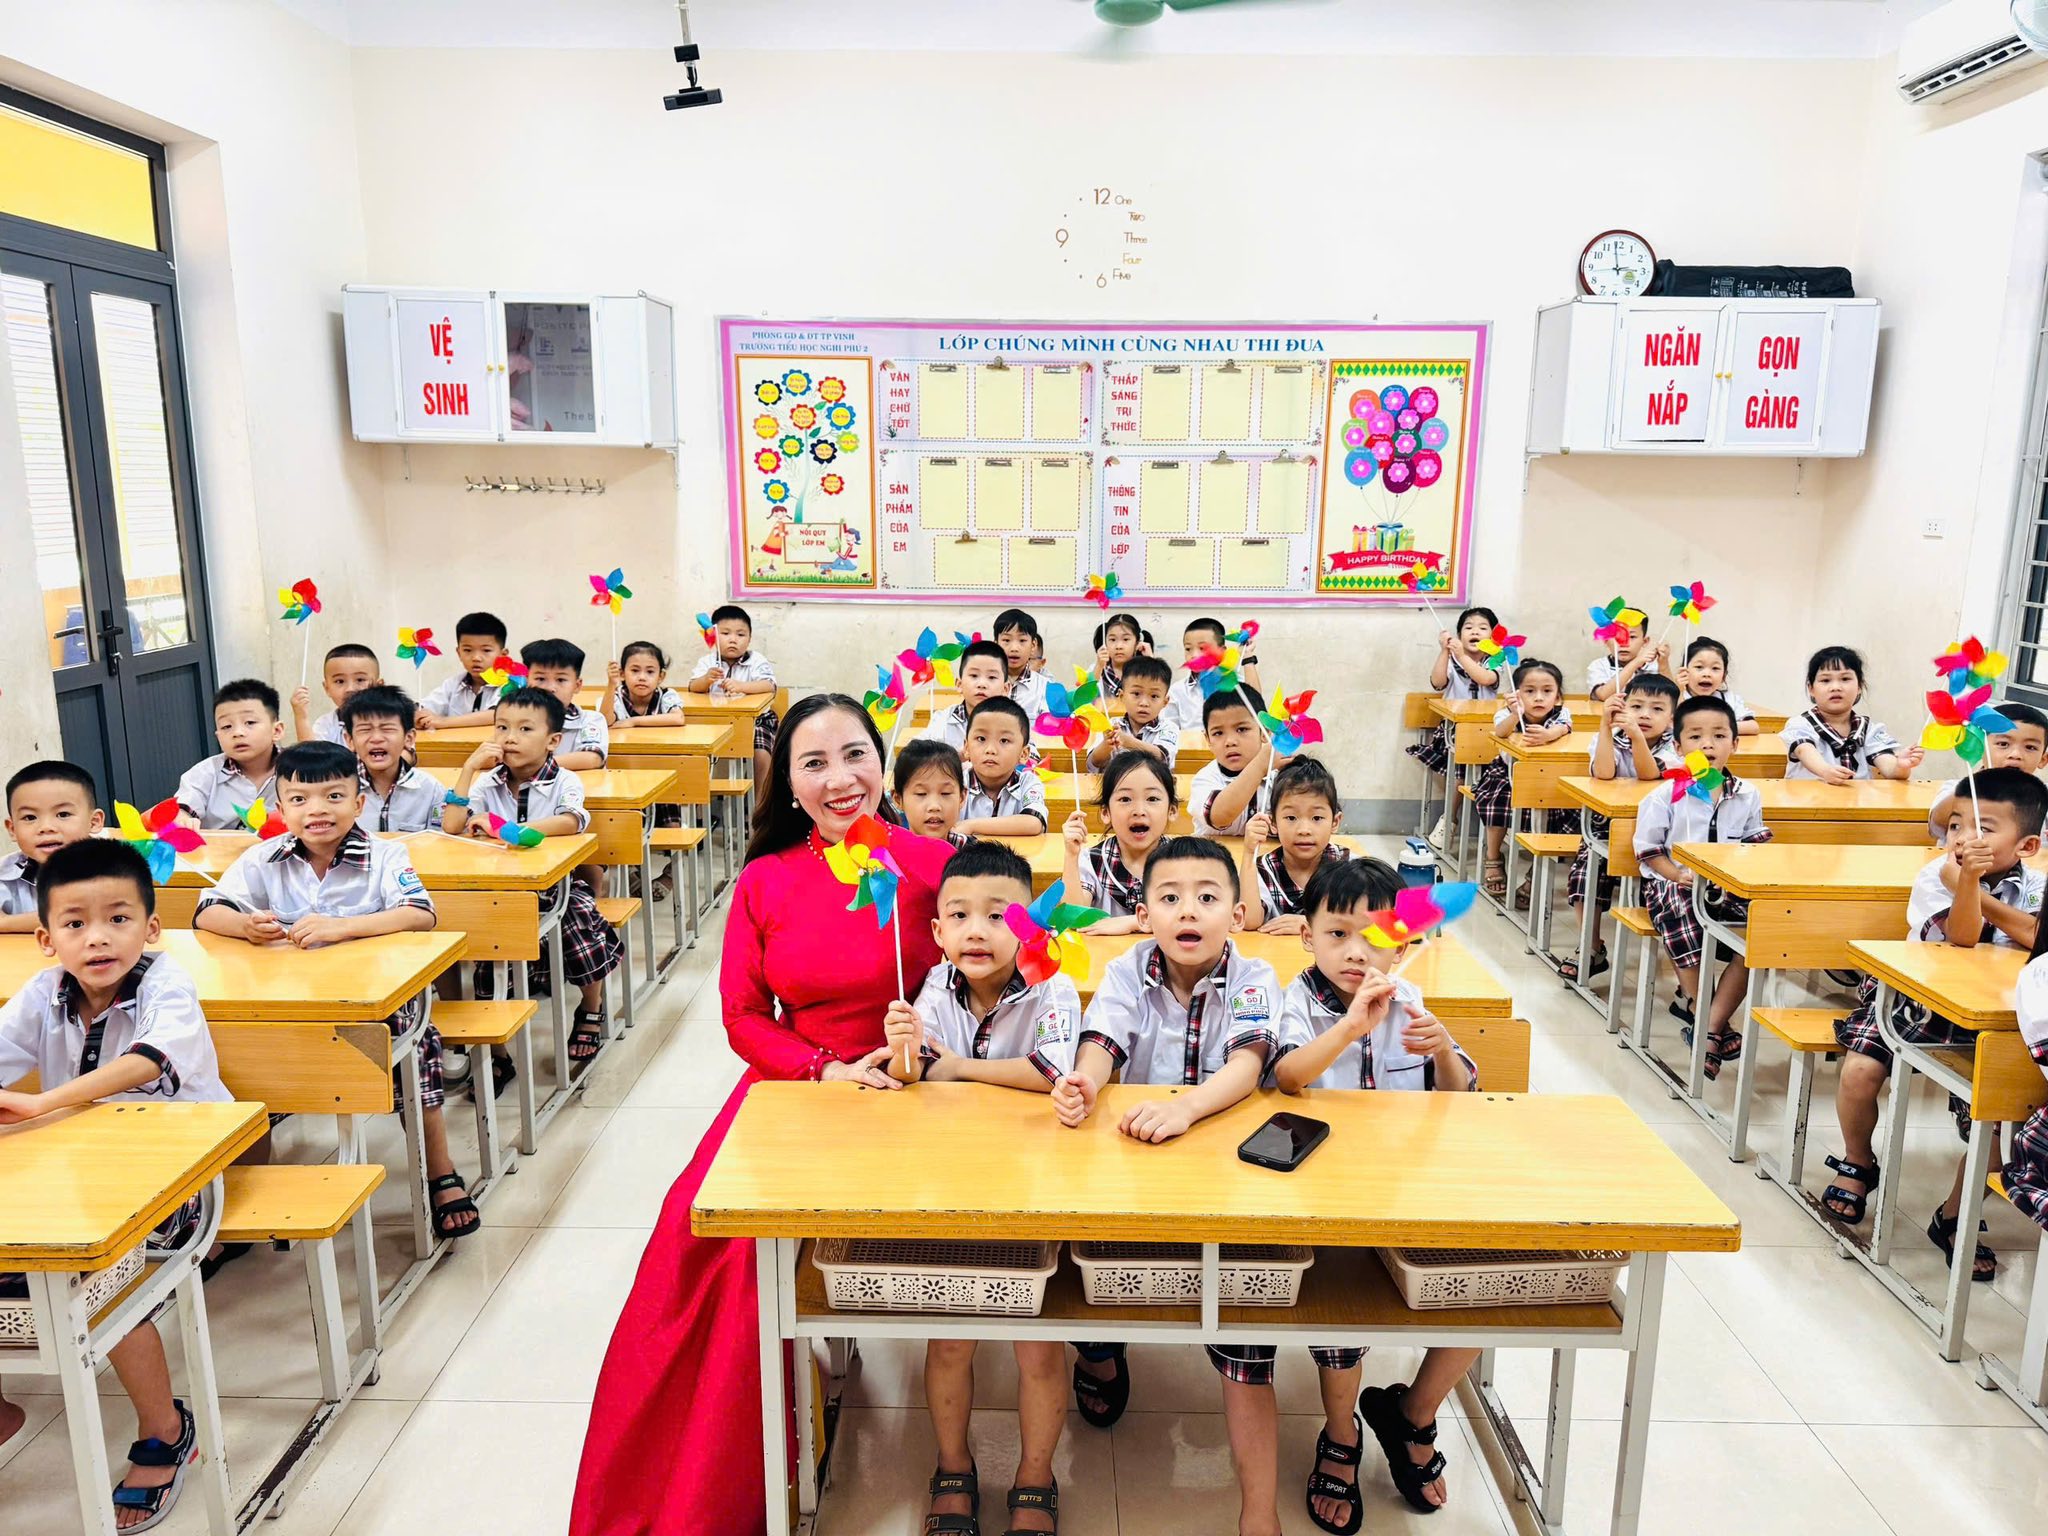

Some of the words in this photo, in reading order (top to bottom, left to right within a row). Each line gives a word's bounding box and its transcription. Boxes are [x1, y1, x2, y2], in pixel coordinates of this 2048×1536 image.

[1094, 188, 1111, 205] 12
[1056, 228, 1069, 248] 9
[1603, 243, 1610, 252] 11
[1630, 245, 1633, 253] 1
[1594, 251, 1603, 259] 10
[1637, 255, 1643, 263] 2
[1640, 268, 1646, 276] 3
[1096, 273, 1107, 288] 6
[1634, 280, 1640, 288] 4
[1624, 287, 1630, 295] 5
[429, 316, 453, 365] VỆ
[833, 333, 855, 341] VINH
[939, 334, 979, 350] LỚP
[984, 335, 1055, 351] CHÚNG
[1061, 335, 1115, 351] MÌNH
[1121, 336, 1177, 352] CÙNG
[1183, 338, 1239, 352] NHAU
[1245, 338, 1280, 351] THI
[1286, 339, 1324, 352] ĐUA
[1644, 326, 1701, 366] NGĂN
[1758, 336, 1800, 377] GỌN
[890, 388, 910, 397] HAY
[423, 382, 469, 416] SINH
[1647, 379, 1689, 425] NẮP
[1745, 388, 1800, 429] GÀNG
[1113, 505, 1129, 516] TIN
[893, 541, 907, 552] EM
[1347, 555, 1379, 564] HAPPY
[1381, 554, 1428, 564] BIRTHDAY
[1326, 1482, 1347, 1494] SPORT
